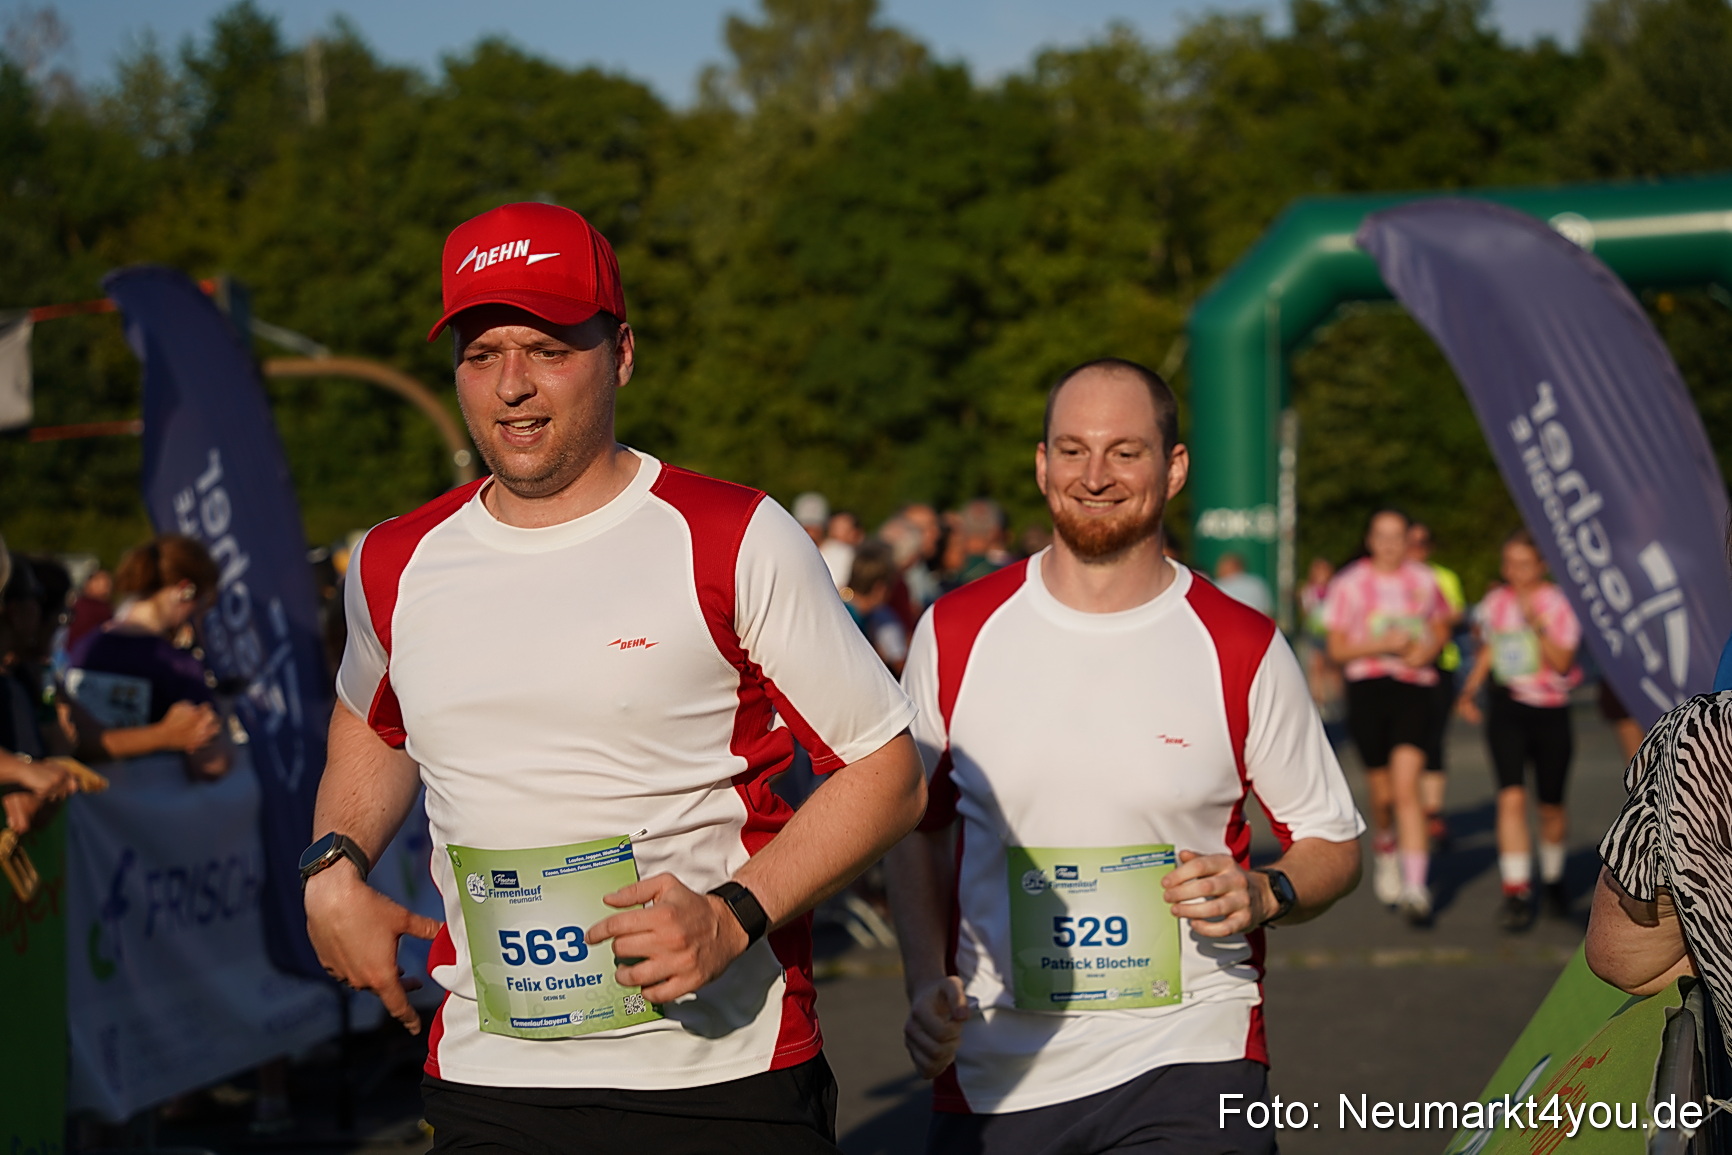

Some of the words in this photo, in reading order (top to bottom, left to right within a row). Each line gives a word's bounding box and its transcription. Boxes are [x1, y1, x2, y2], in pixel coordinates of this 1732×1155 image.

[473, 238, 531, 273] DEHN
[619, 637, 647, 650] DEHN
[488, 884, 542, 899] Firmenlauf
[509, 895, 542, 905] neumarkt
[1053, 915, 1129, 949] 529
[498, 926, 589, 967] 563
[1041, 956, 1093, 971] Patrick
[1096, 956, 1151, 969] Blocher
[506, 976, 543, 992] Felix
[545, 973, 604, 991] Gruber
